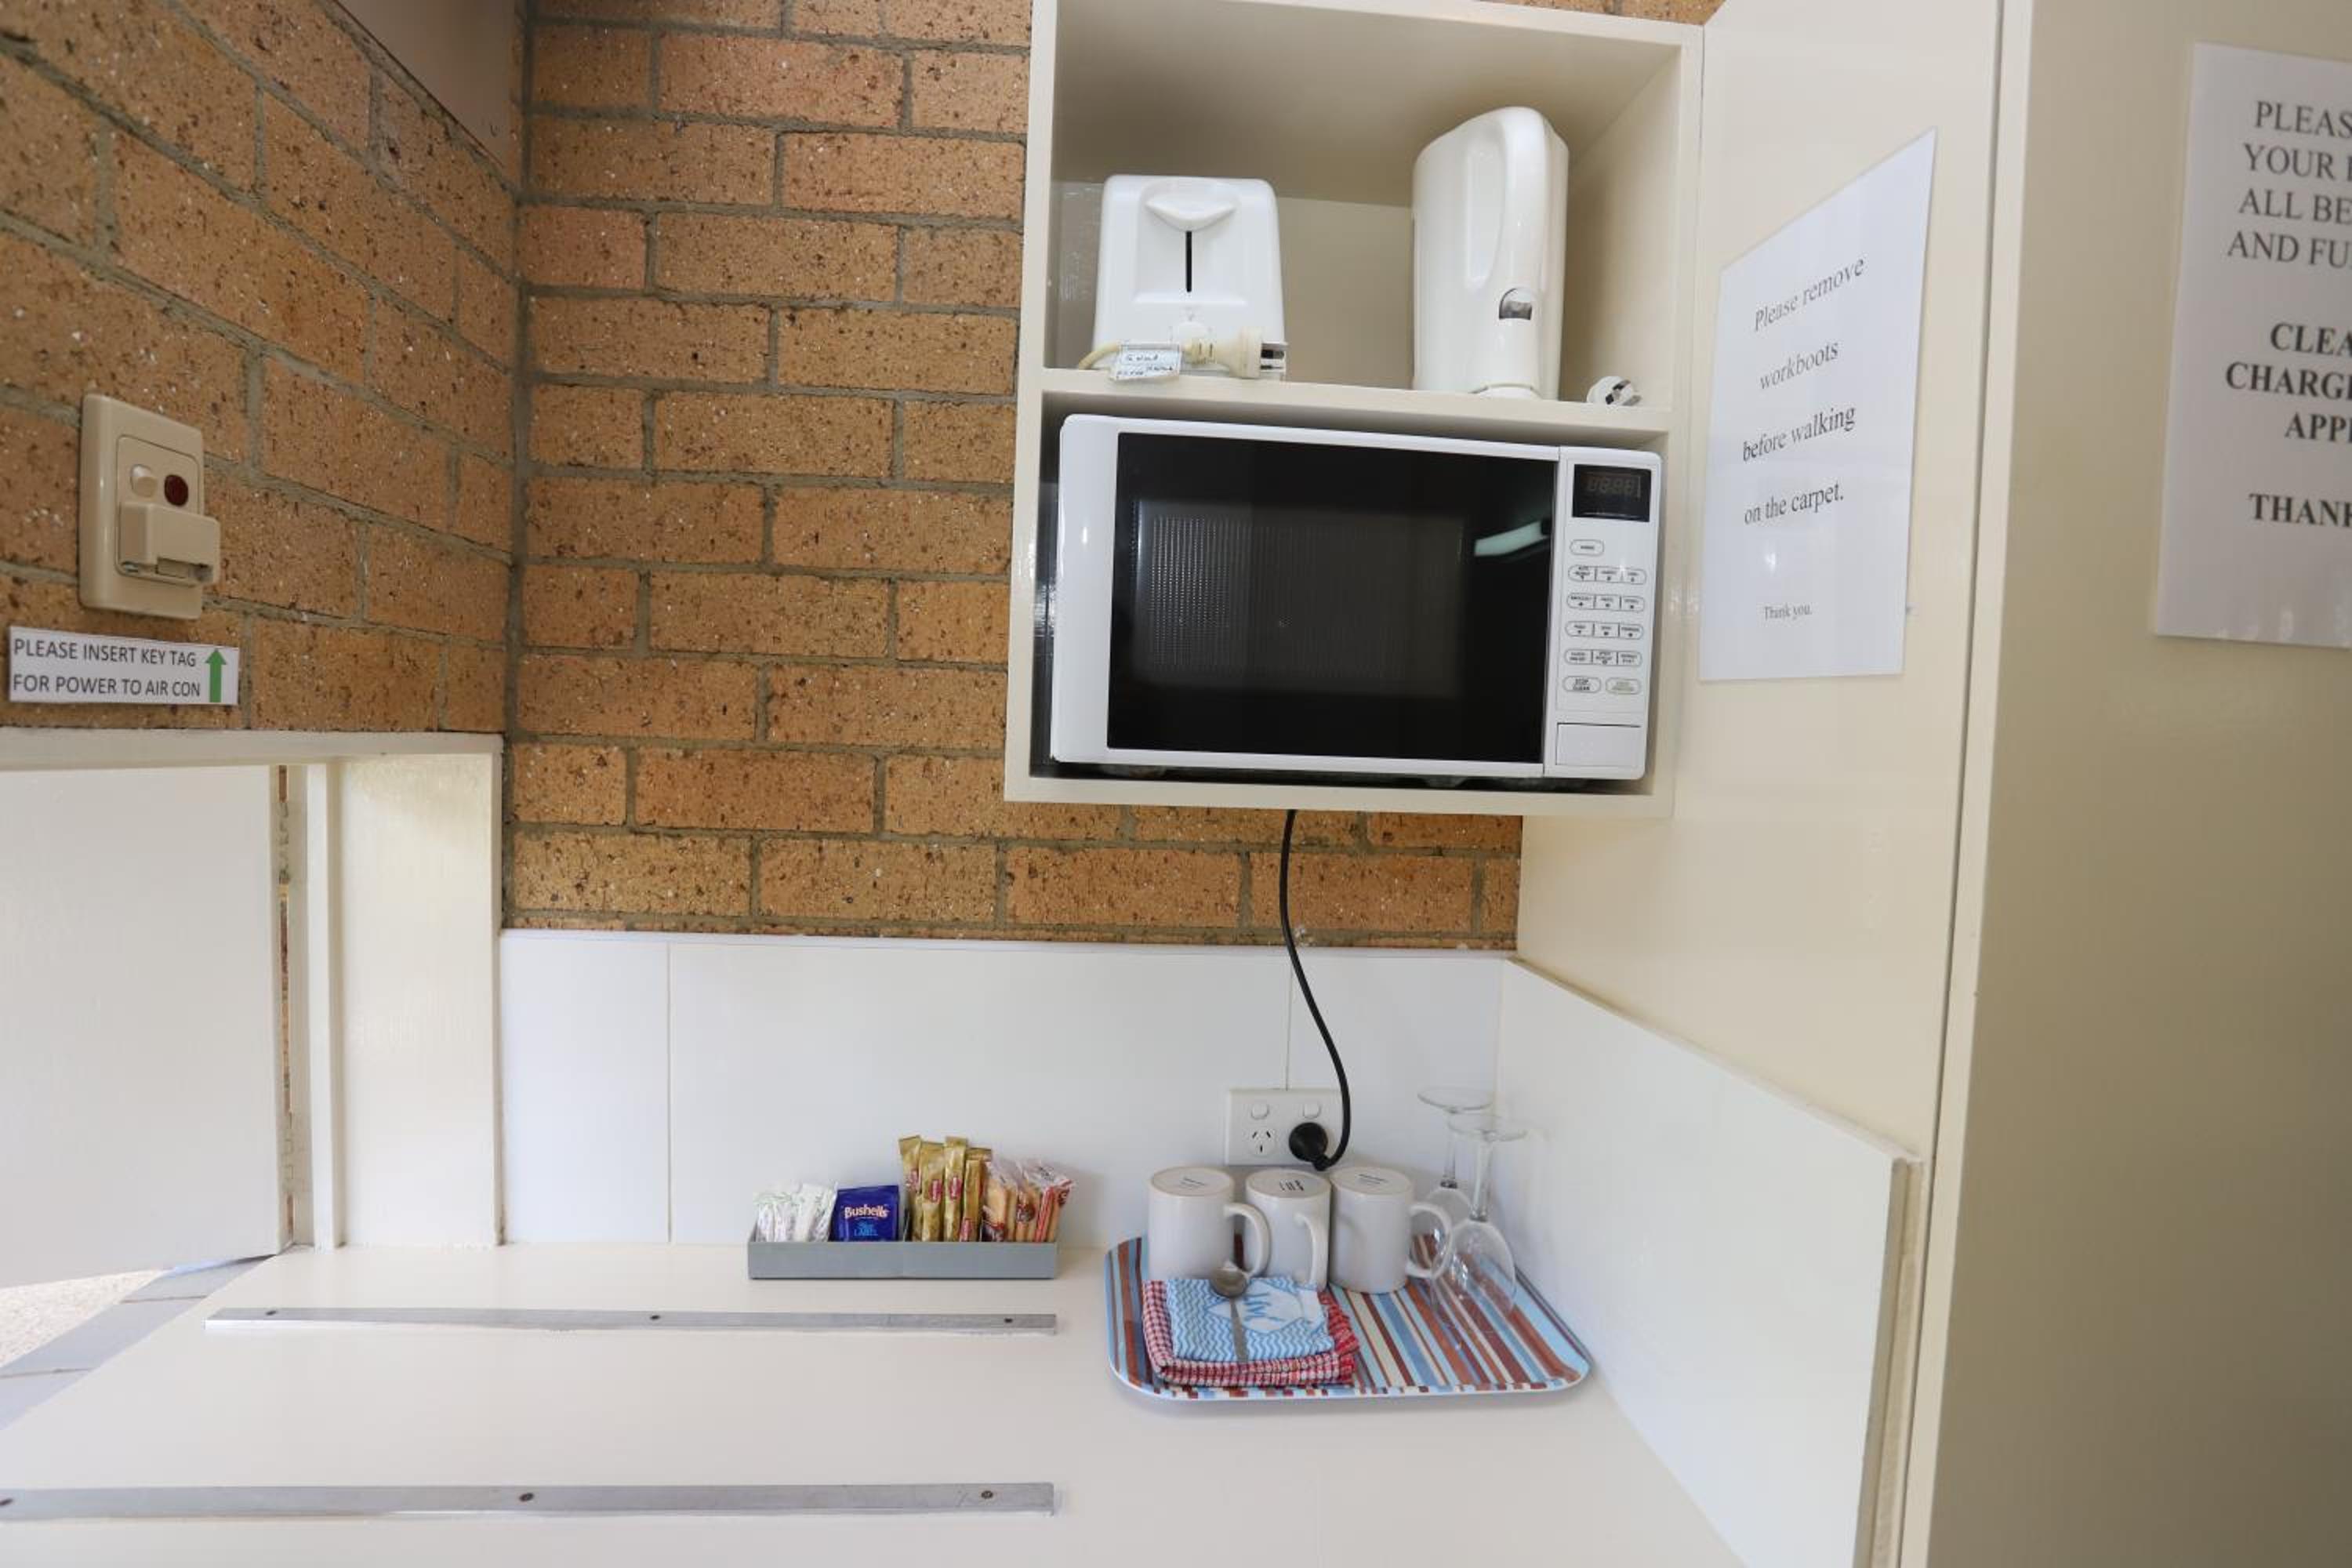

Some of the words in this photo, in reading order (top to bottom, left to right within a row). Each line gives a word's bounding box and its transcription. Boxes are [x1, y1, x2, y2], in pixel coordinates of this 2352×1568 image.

[2244, 143, 2336, 181] YOUR
[2238, 188, 2303, 220] ALL
[2227, 230, 2300, 263] AND
[1755, 295, 1799, 332] Please
[1802, 259, 1864, 306] remove
[1759, 343, 1839, 390] workboots
[1743, 432, 1788, 462] before
[1791, 408, 1856, 444] walking
[2285, 412, 2352, 444] APP
[1744, 506, 1761, 525] on
[1765, 495, 1788, 519] the
[1791, 480, 1844, 514] carpet.
[14, 638, 78, 660] PLEASE
[83, 644, 137, 664] INSERT
[141, 648, 166, 666] KEY
[169, 651, 197, 667] TAG
[13, 674, 49, 692] FOR
[56, 676, 117, 695] POWER
[121, 678, 142, 695] TO
[144, 680, 169, 696] AIR
[172, 681, 201, 697] CON
